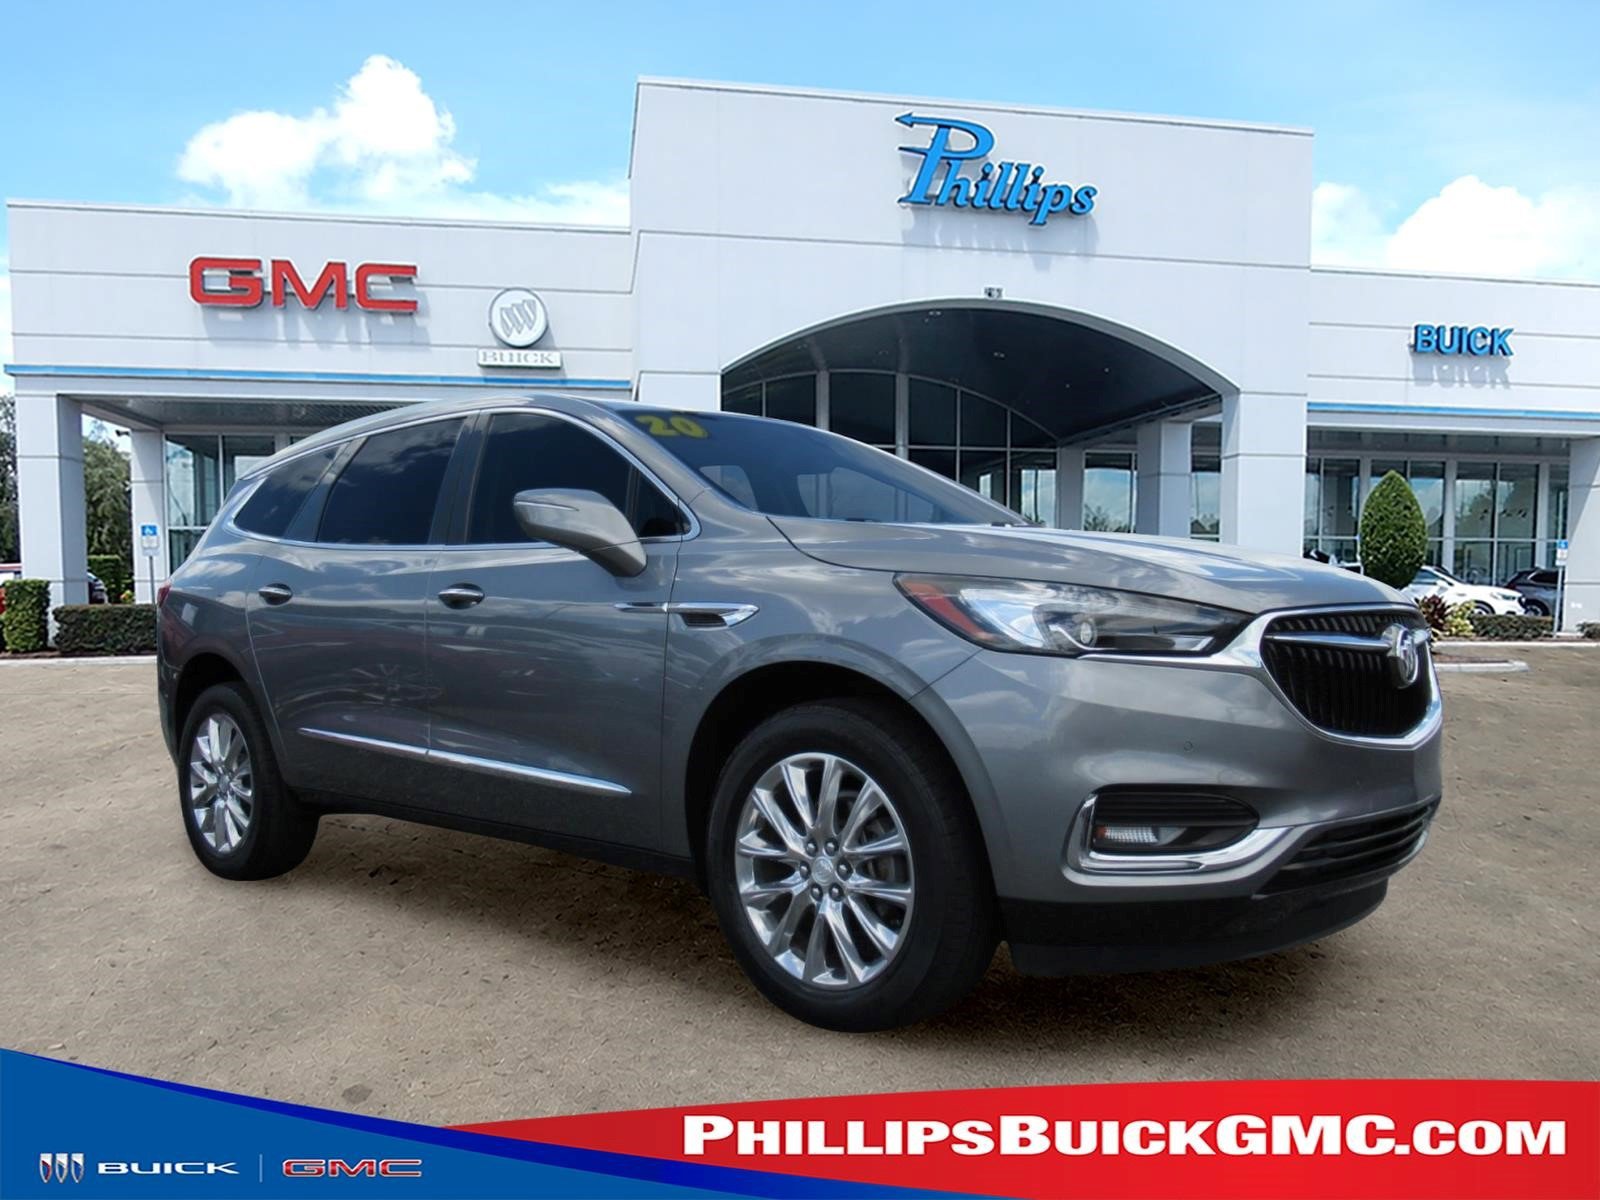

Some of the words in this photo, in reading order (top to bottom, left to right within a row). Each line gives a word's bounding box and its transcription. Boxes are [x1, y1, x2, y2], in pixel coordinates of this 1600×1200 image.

[895, 112, 1097, 226] Phillips
[189, 256, 419, 313] GMC
[1413, 324, 1514, 356] BUICK
[482, 351, 554, 364] BUICK
[634, 415, 709, 438] 20
